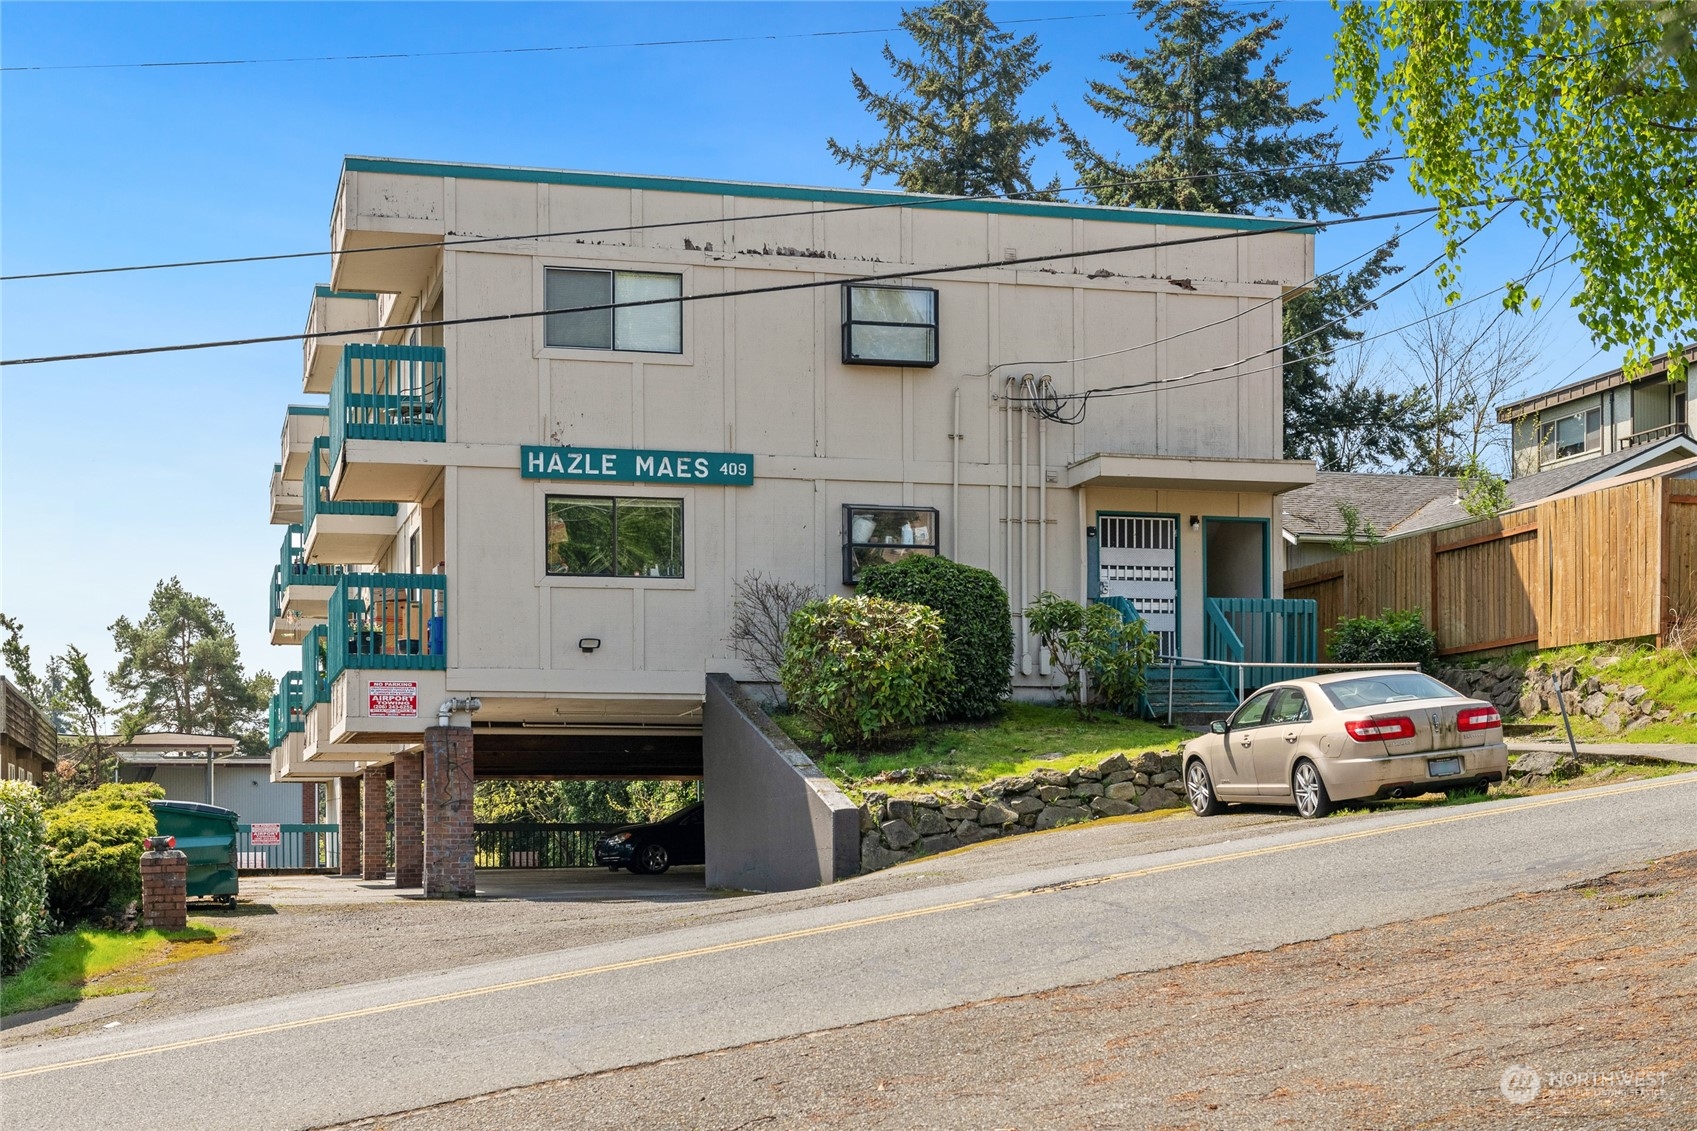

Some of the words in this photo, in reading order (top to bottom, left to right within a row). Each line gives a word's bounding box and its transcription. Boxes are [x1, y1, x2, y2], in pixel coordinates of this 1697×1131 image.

[528, 452, 617, 475] HAZLE
[635, 455, 709, 478] MAES
[719, 462, 747, 476] 409
